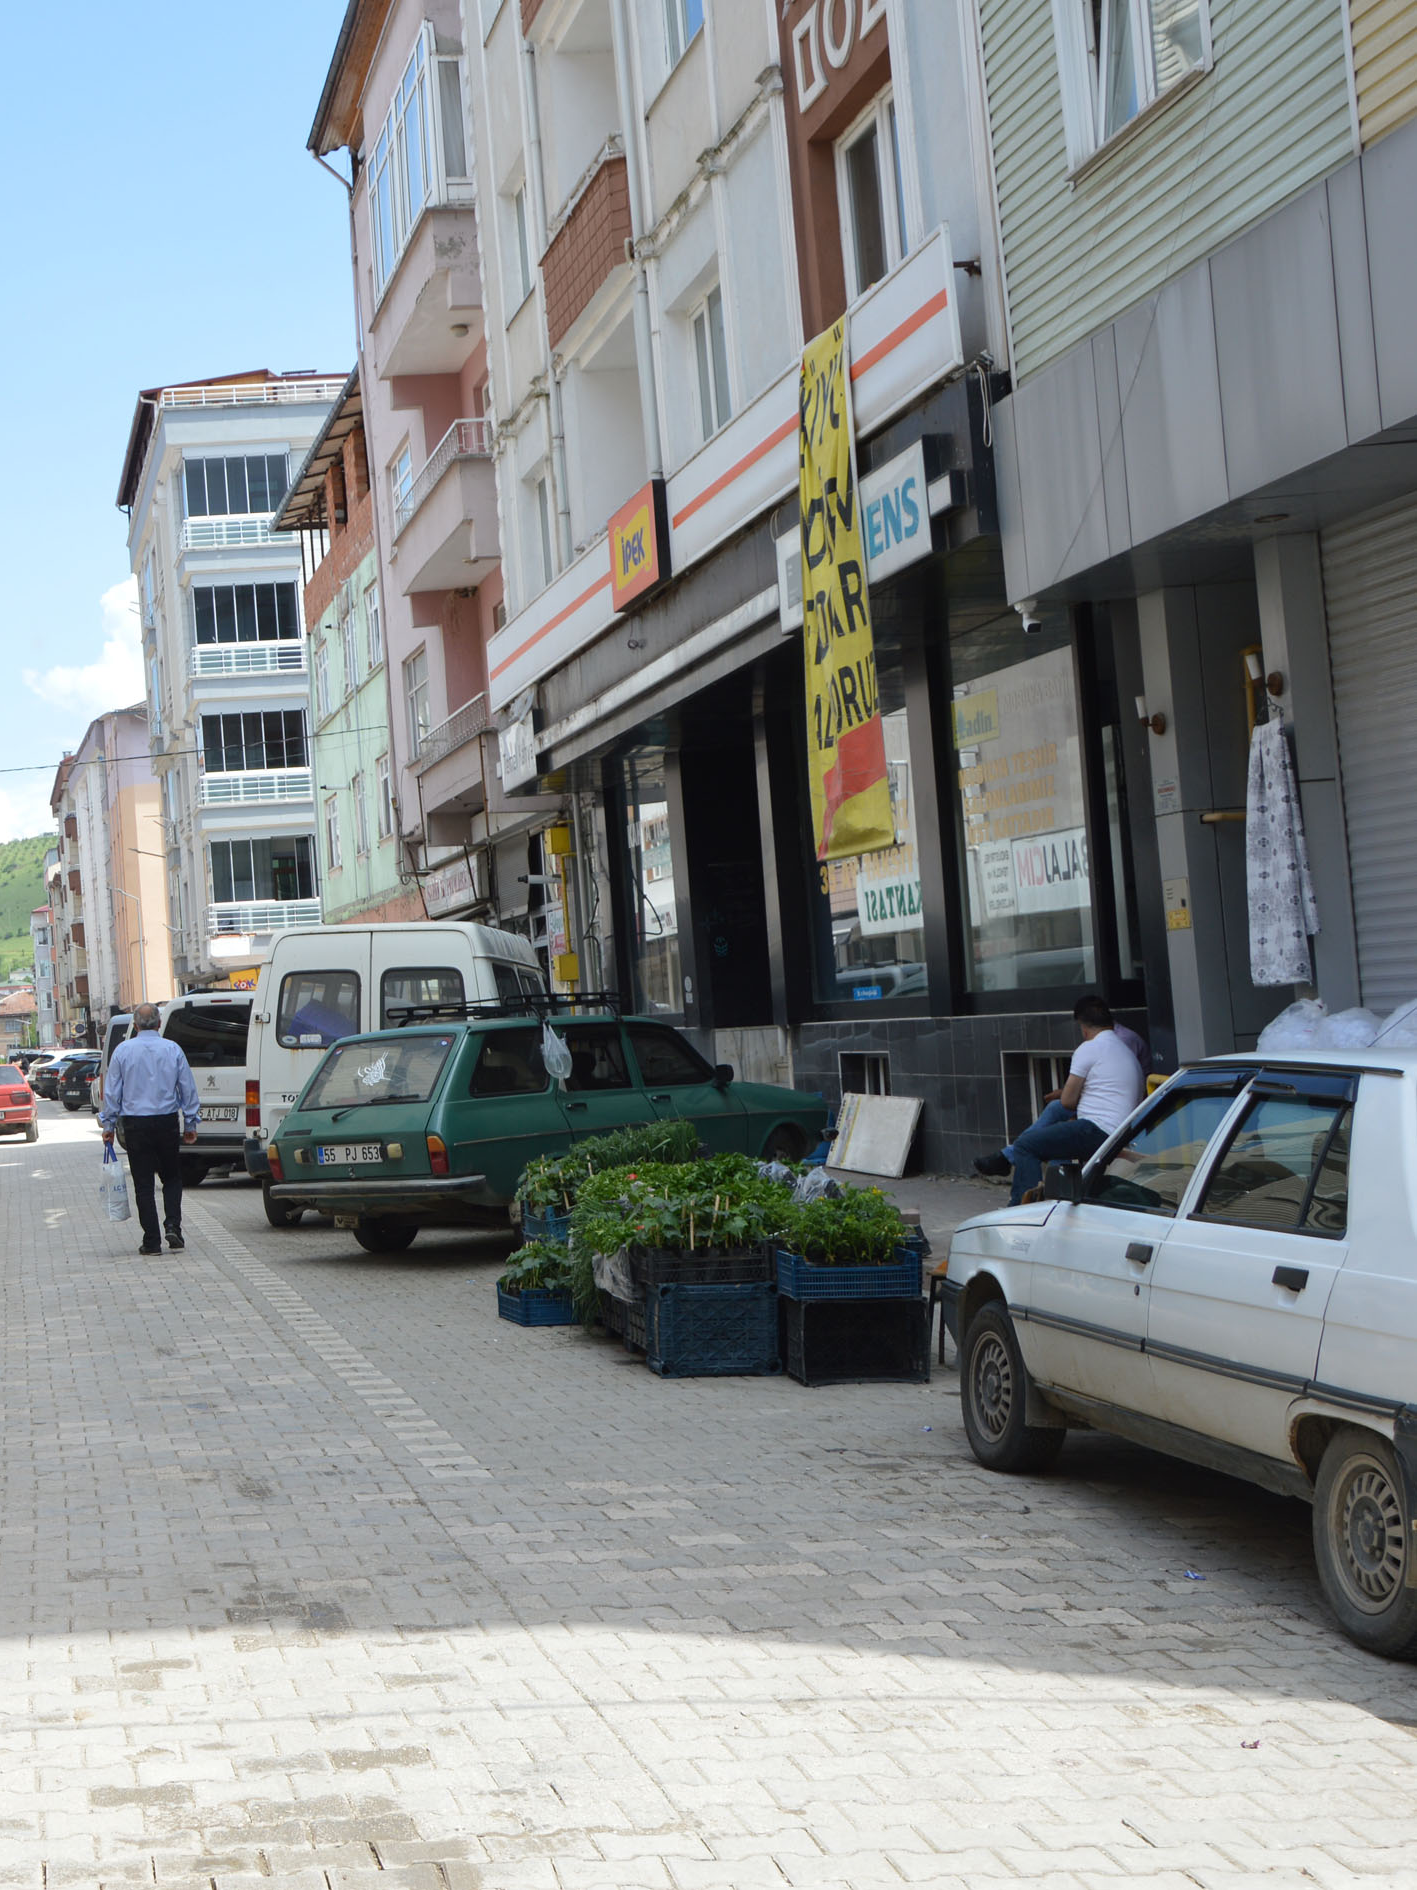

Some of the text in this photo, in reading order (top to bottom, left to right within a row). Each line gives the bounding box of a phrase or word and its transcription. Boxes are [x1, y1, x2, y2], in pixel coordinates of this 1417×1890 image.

[207, 1108, 220, 1118] ATJ
[223, 1108, 236, 1118] 018
[324, 1148, 336, 1162] 55
[345, 1147, 357, 1161] PJ
